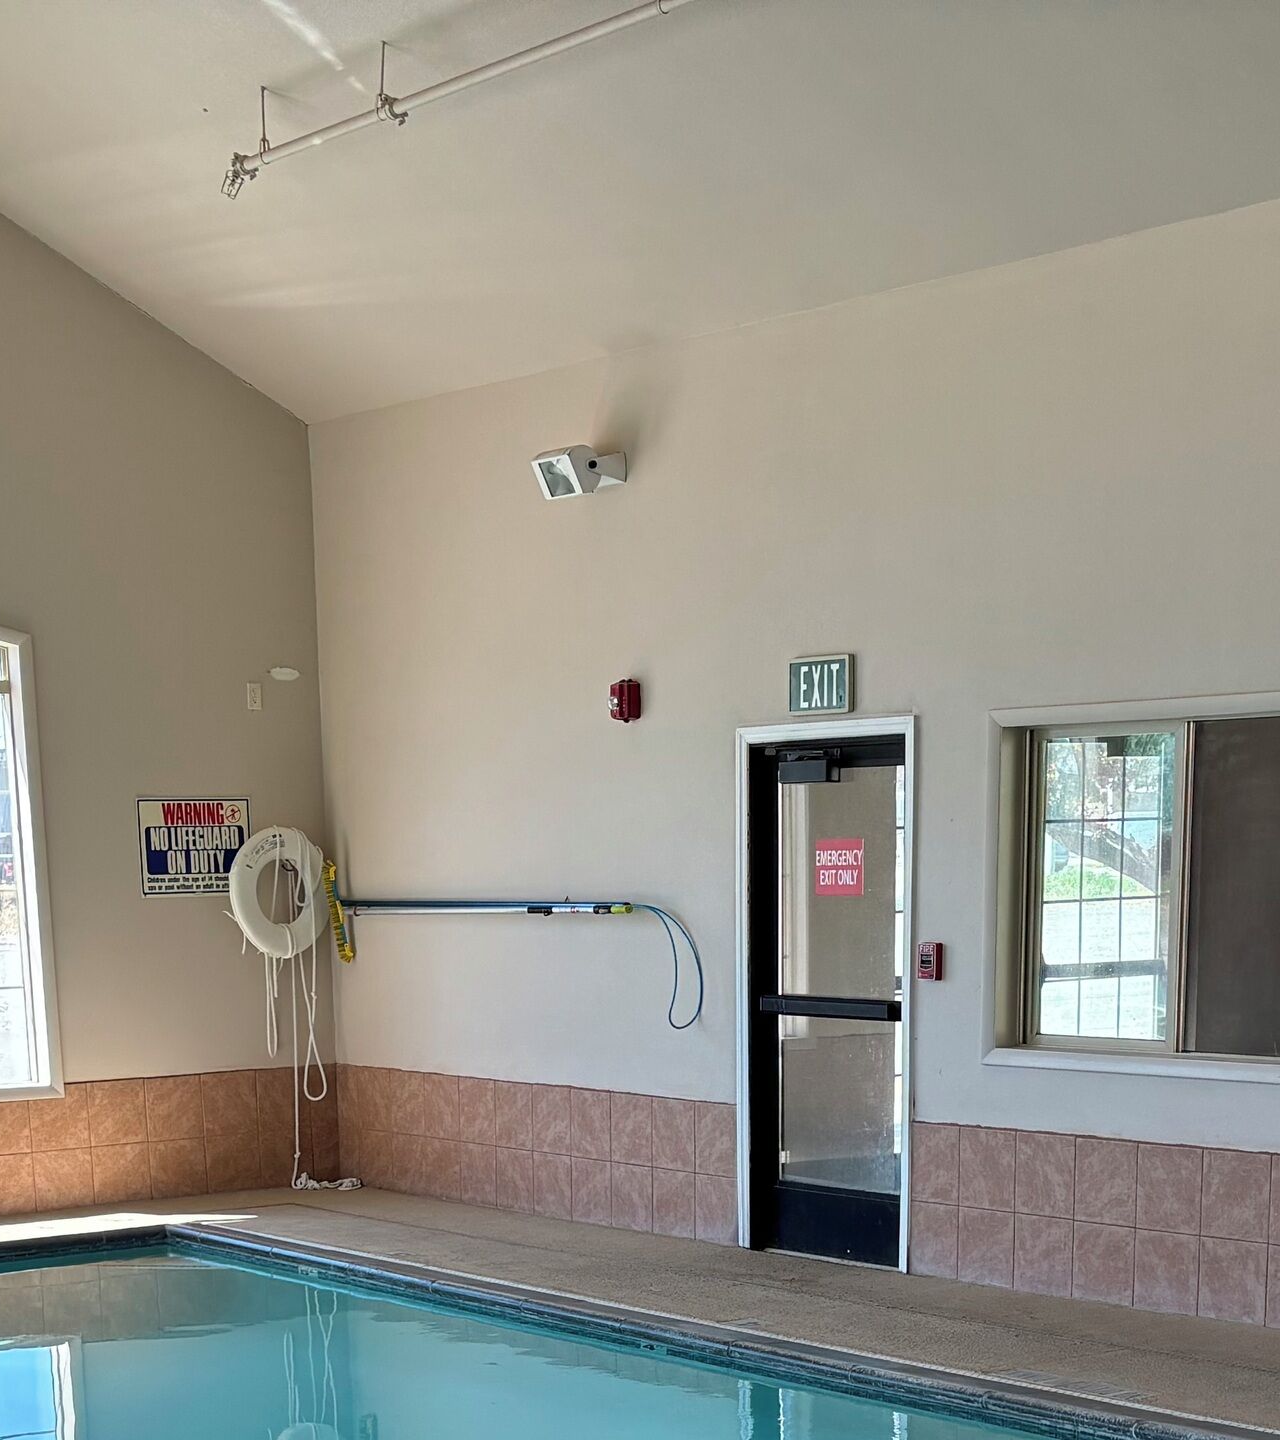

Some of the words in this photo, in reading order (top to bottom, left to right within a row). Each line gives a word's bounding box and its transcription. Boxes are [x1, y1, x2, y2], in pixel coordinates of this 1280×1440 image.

[800, 663, 840, 708] EXIT
[162, 803, 225, 825] WARNING
[150, 827, 169, 851] NO
[170, 826, 240, 850] LIFEGUARD
[167, 850, 187, 874] ON
[190, 850, 226, 873] DUTY
[816, 850, 862, 866] EMERGENCY
[820, 870, 836, 885] EXIT
[837, 869, 858, 885] ONLY
